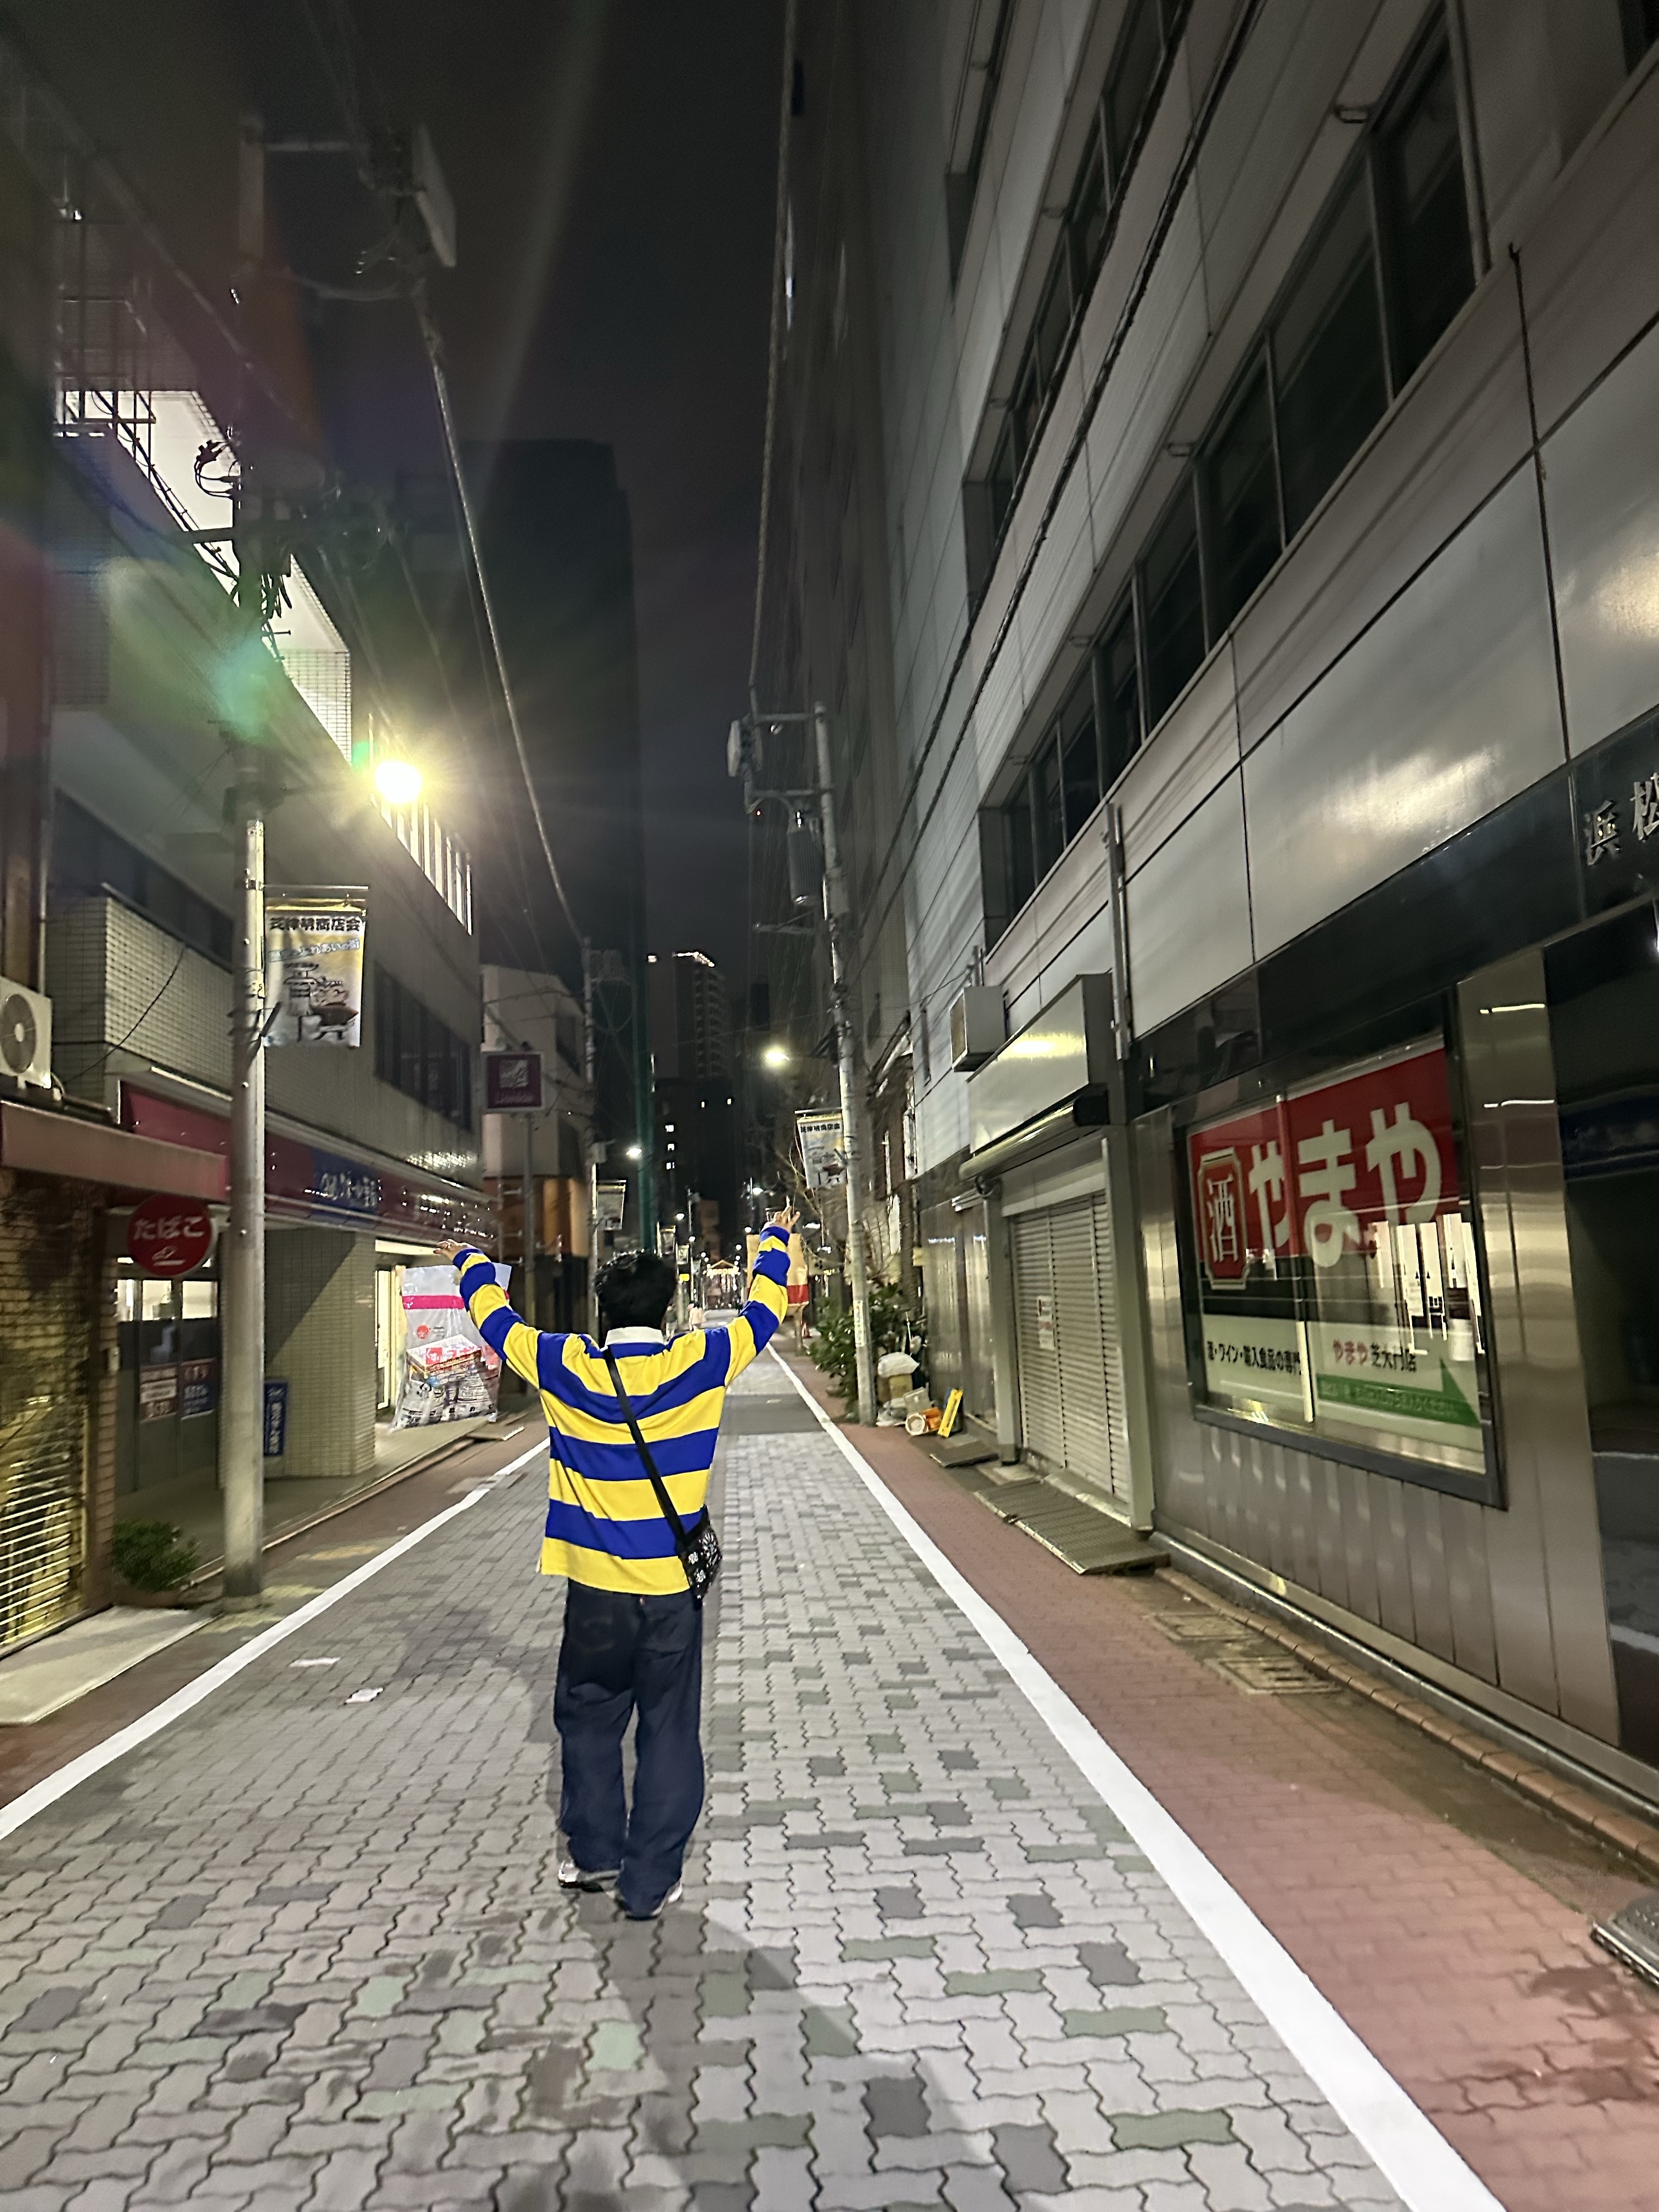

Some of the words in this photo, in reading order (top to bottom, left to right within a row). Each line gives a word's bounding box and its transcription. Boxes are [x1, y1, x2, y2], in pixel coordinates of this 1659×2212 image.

[1207, 1174, 1238, 1262] 酒
[1249, 1102, 1441, 1270] やまや
[134, 1215, 204, 1240] たばこ
[1333, 1339, 1368, 1366] やまや
